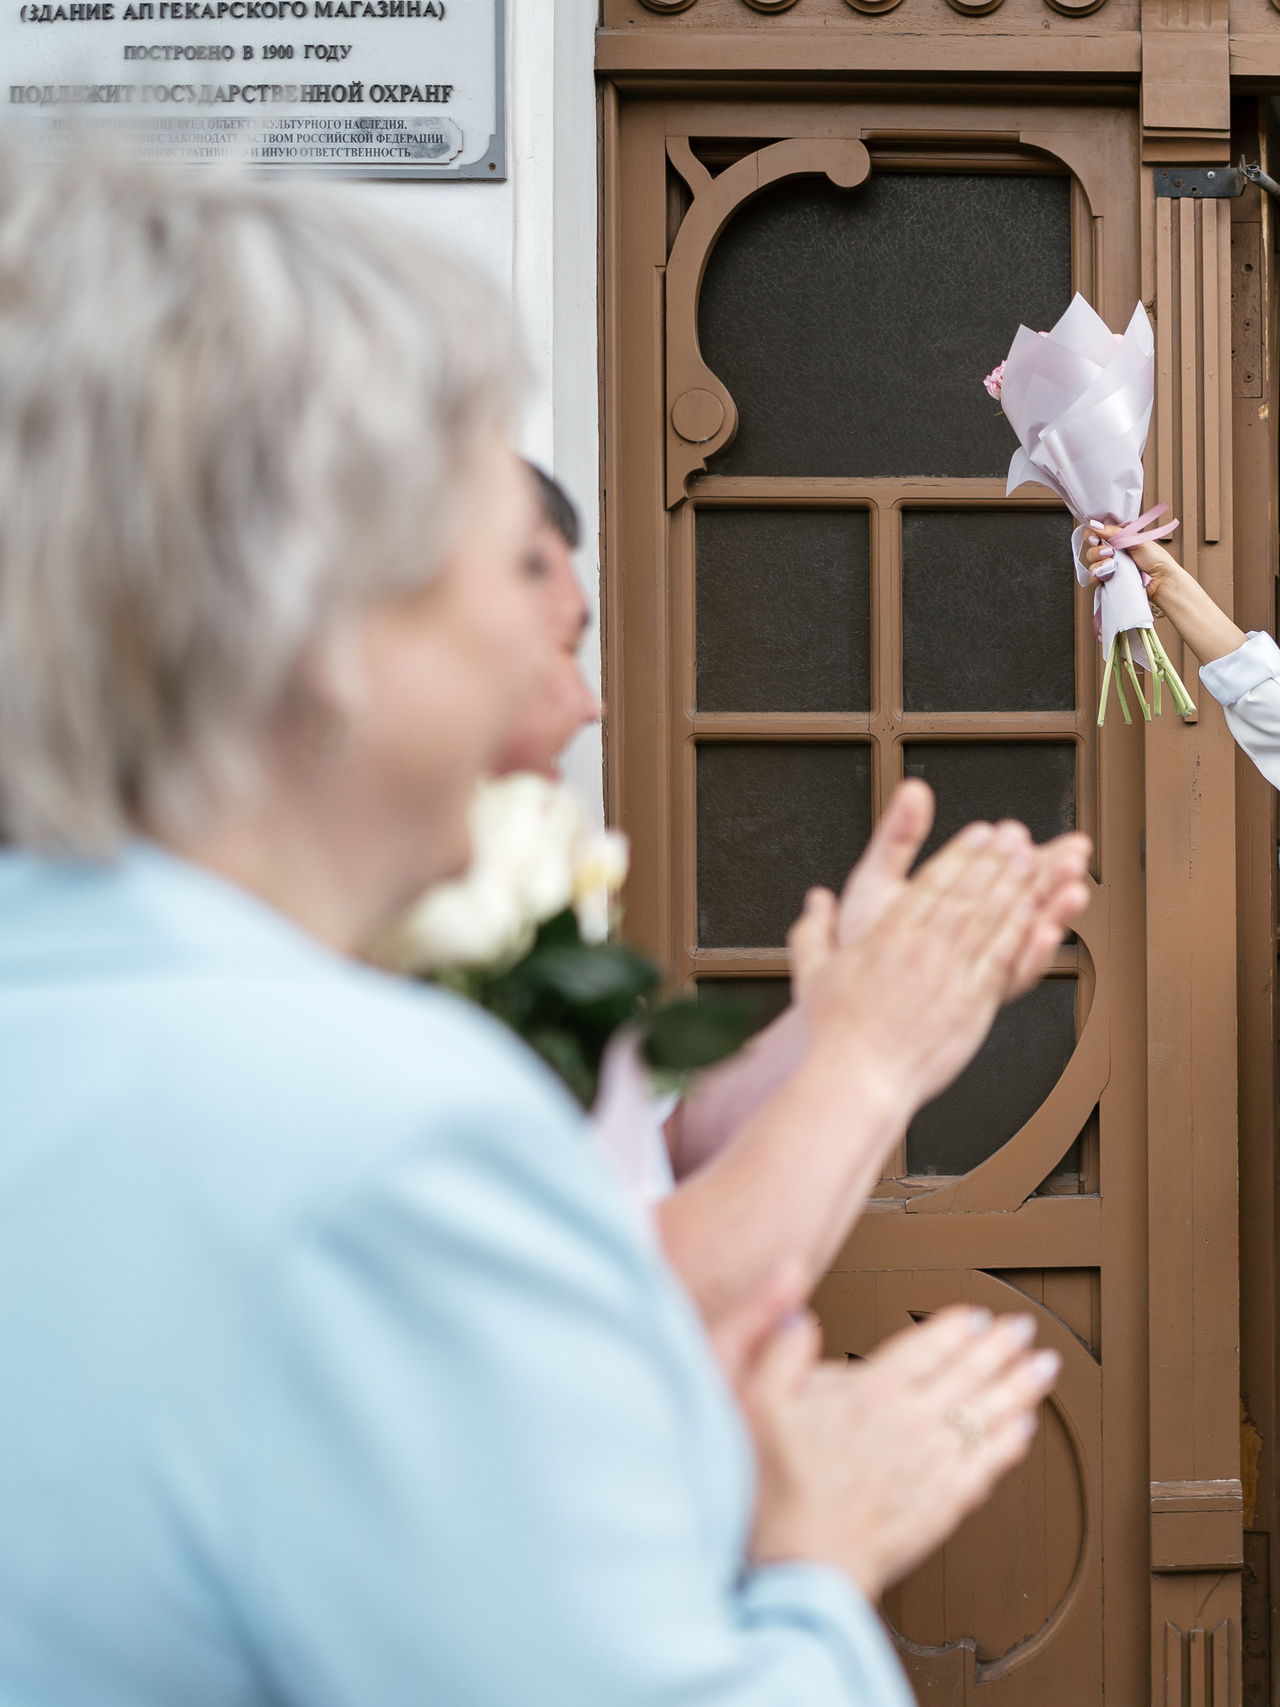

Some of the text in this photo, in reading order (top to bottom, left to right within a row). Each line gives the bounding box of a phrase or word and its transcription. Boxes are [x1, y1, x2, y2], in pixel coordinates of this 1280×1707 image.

[20, 4, 115, 23] (ЗДАНИЕ
[314, 0, 446, 21] МАГАЗИНА)
[123, 45, 352, 62] ПОСТРОЕНО В 1900 ГОДУ
[9, 84, 136, 107] ПОДЛЕЖИТ
[140, 81, 364, 106] ГОСУДАРСТВЕННОЙ
[262, 119, 342, 130] КУЛЬТУРНОГО
[344, 119, 408, 131] НАСЛЕДИЯ,
[296, 131, 374, 144] РОССИЙСКОЙ
[376, 133, 444, 146] ФЕДЕРАЦИИ
[262, 147, 298, 158] ИНУЮ
[300, 147, 412, 158] ОТВЕТСТВЕННОСТЬ
